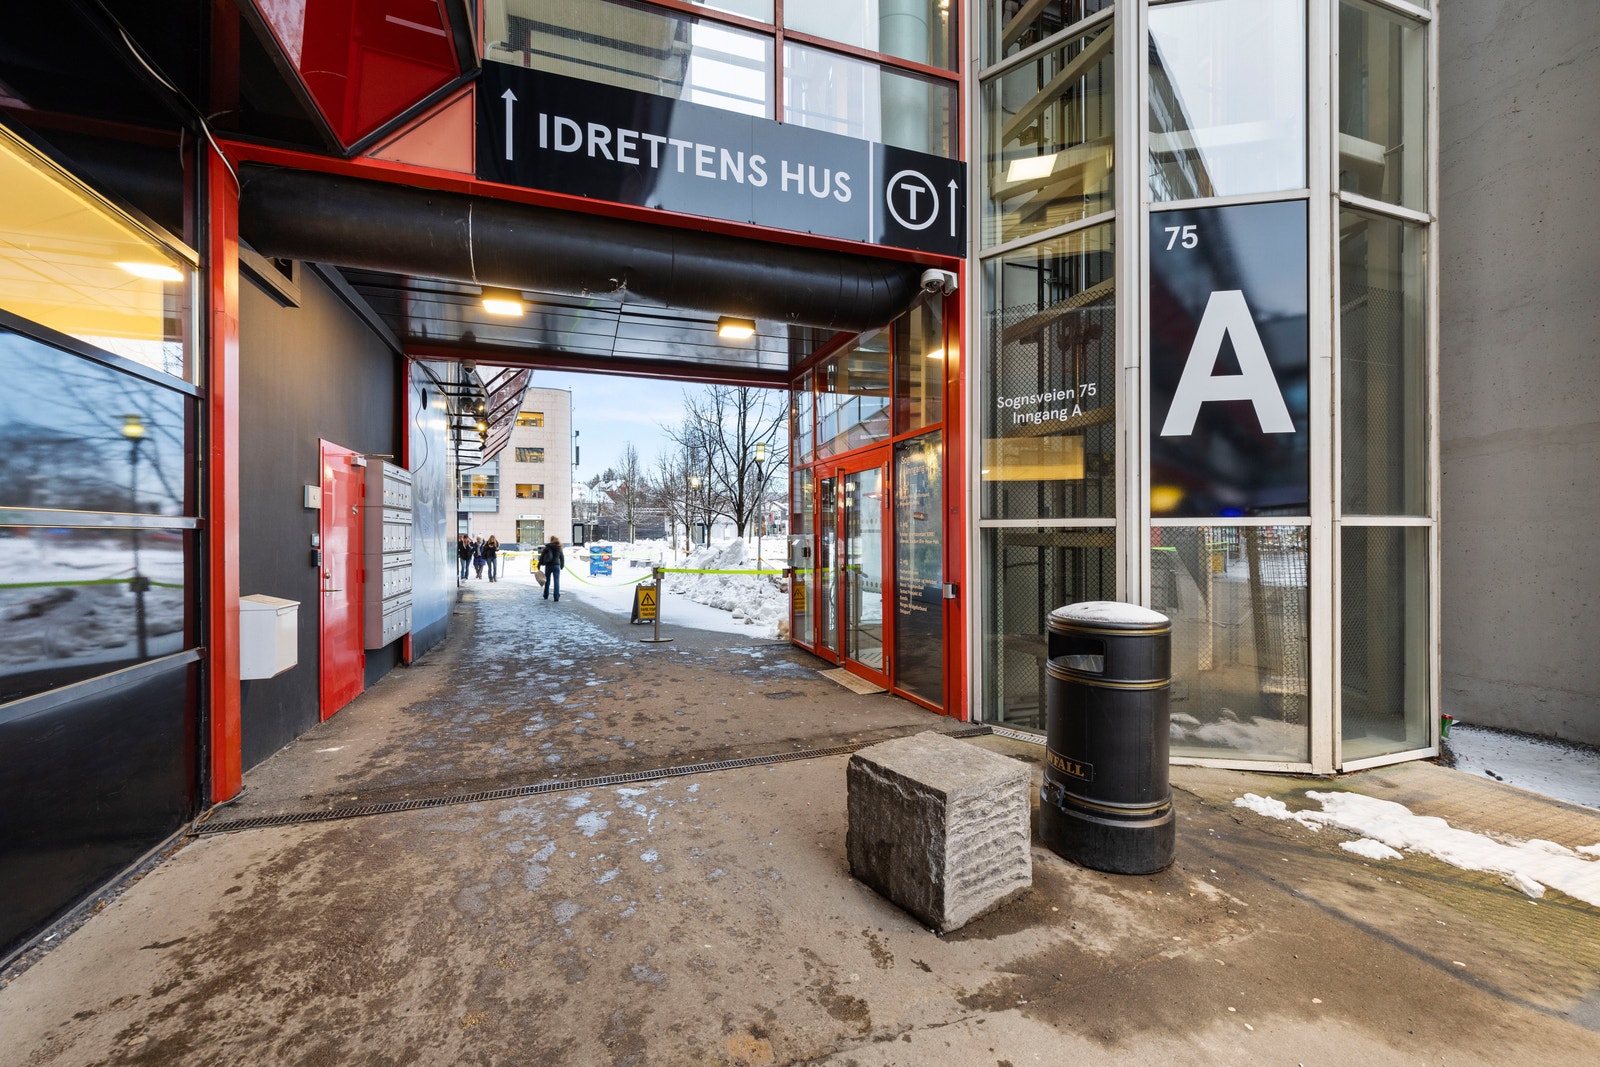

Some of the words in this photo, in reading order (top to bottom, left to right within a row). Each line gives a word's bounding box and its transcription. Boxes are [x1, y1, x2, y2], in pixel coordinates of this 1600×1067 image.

[538, 112, 769, 188] IDRETTENS
[780, 160, 852, 203] HUS
[900, 183, 926, 221] T
[1164, 224, 1199, 251] 75
[1160, 289, 1296, 437] A
[997, 388, 1075, 410] Sognsveien
[1079, 382, 1097, 398] 75
[1013, 408, 1068, 424] Inngang
[1071, 403, 1082, 417] A
